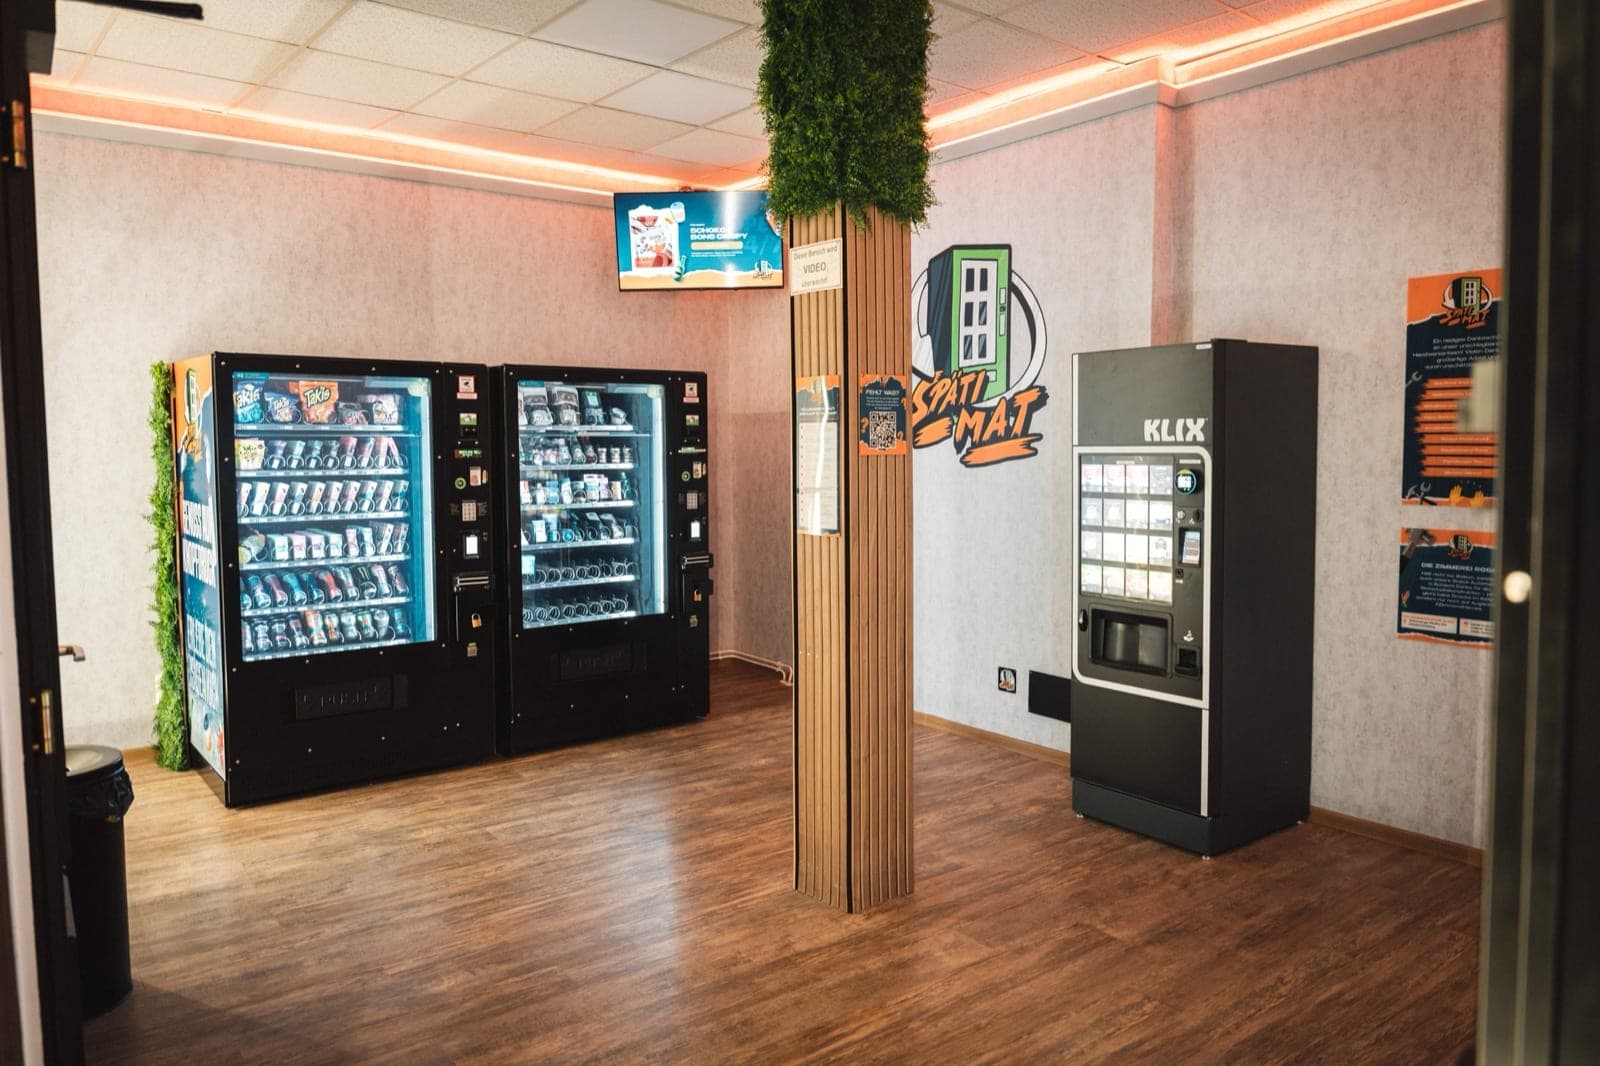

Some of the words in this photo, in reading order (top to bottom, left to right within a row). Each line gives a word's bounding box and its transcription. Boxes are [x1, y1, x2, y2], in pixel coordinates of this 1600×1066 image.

[803, 262, 827, 274] VIDEO
[304, 385, 331, 409] Takis
[912, 370, 986, 426] SPÄTI
[954, 386, 1044, 443] MAT
[1144, 418, 1206, 442] KLIX
